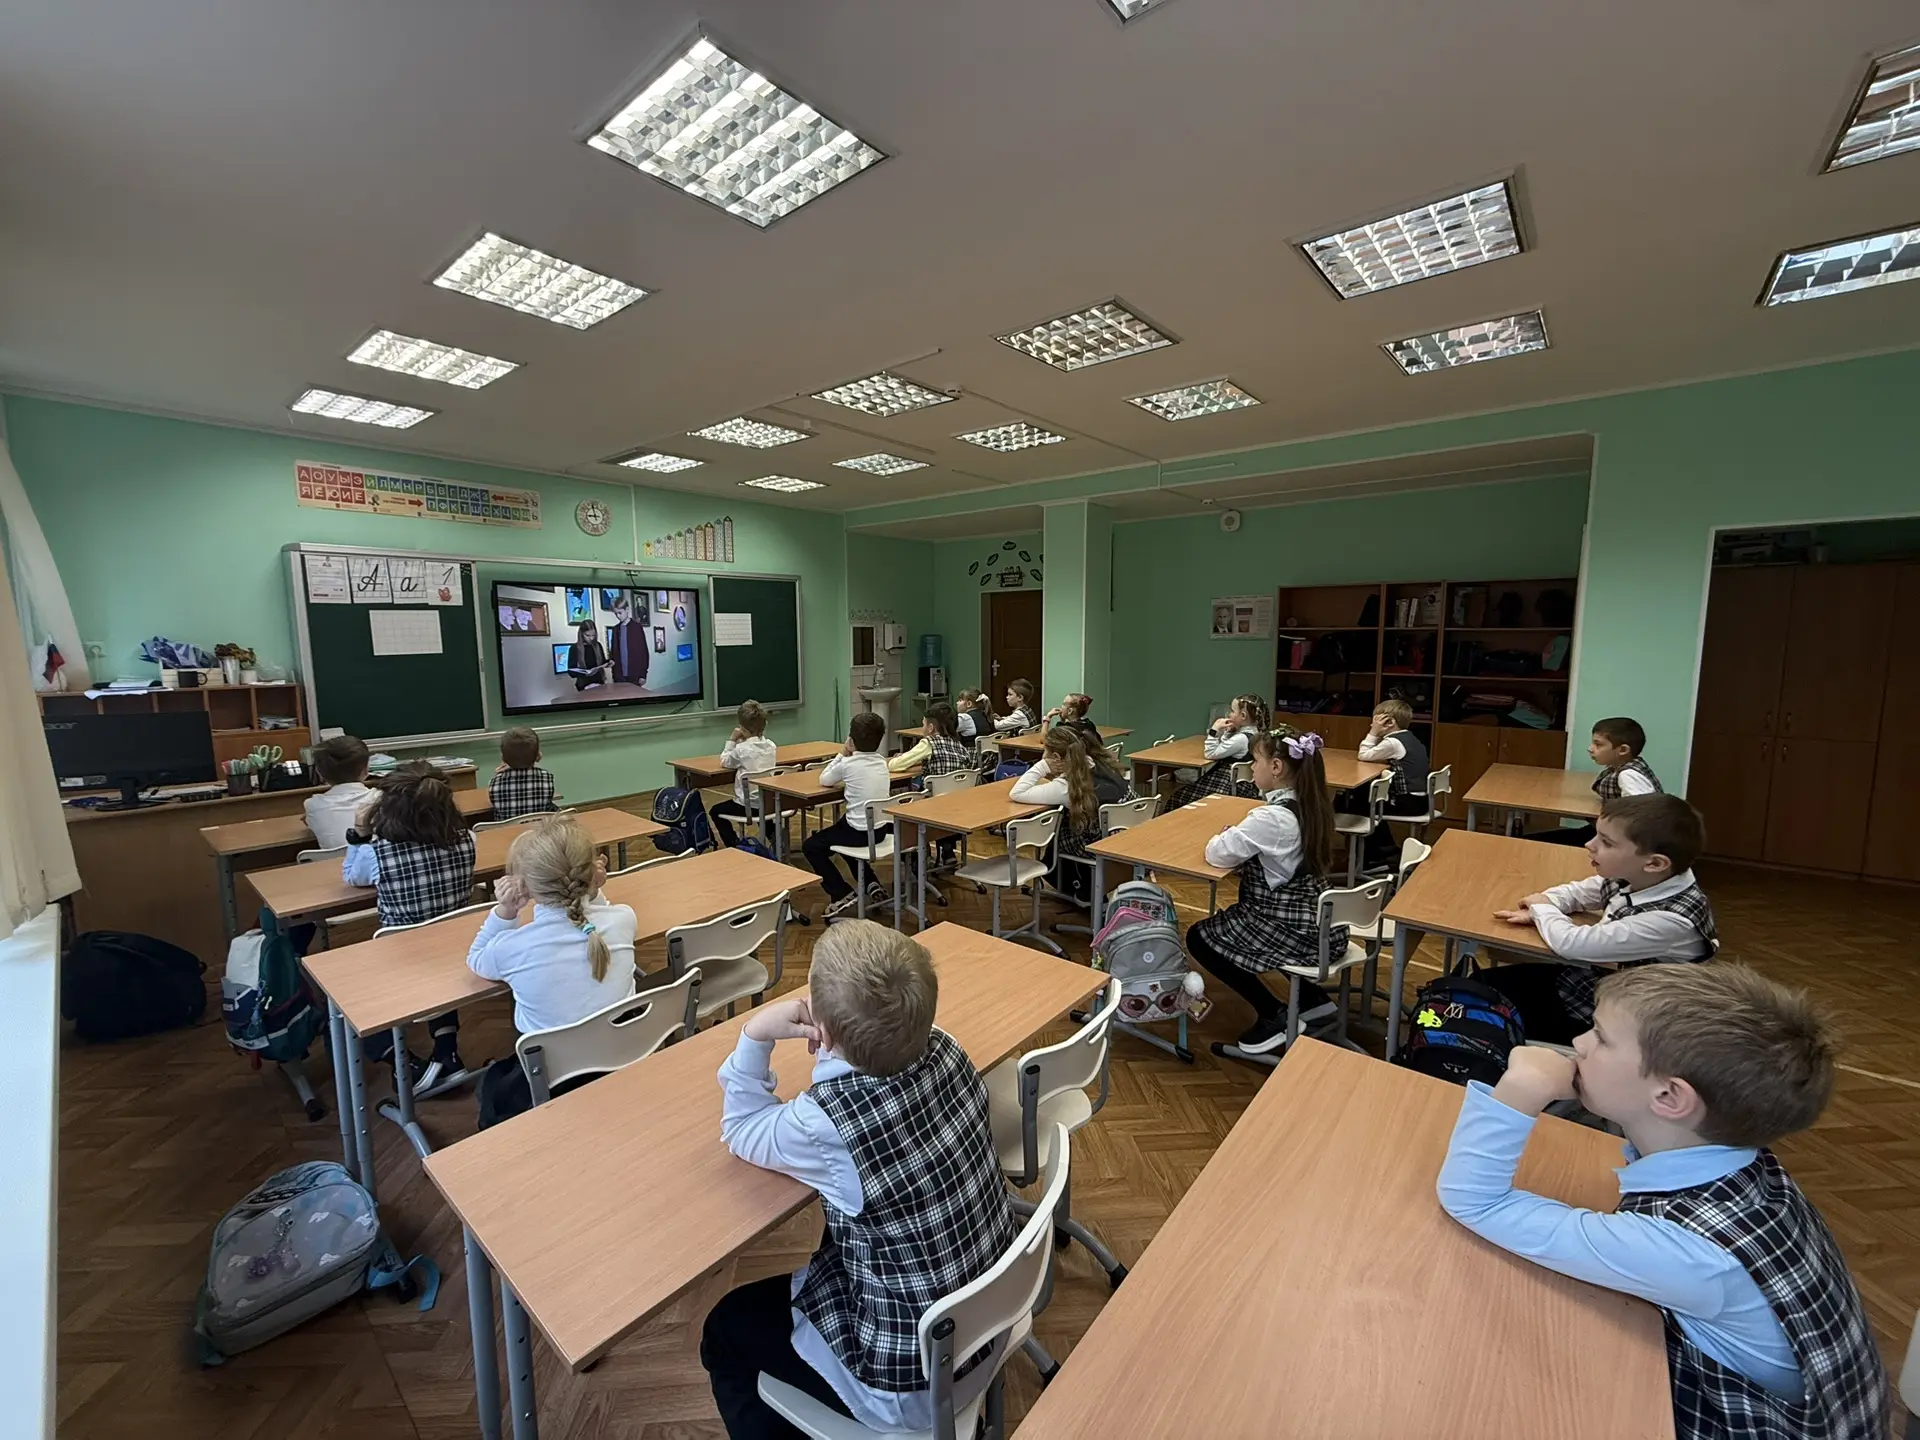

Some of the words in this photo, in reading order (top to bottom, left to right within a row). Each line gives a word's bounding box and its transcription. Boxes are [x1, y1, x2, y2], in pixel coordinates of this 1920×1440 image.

[299, 469, 309, 479] А
[313, 471, 323, 481] О
[327, 473, 336, 482] У
[339, 475, 350, 484] Ы
[353, 476, 363, 485] Э
[379, 479, 388, 488] Л
[390, 482, 400, 491] М
[403, 483, 412, 491] Н
[415, 484, 423, 492] Р
[427, 485, 435, 494] Б
[438, 486, 445, 495] В
[449, 488, 457, 496] Г
[460, 488, 469, 498] Д
[470, 491, 480, 499] Ж
[482, 492, 489, 501] З
[301, 486, 311, 496] Я
[327, 489, 340, 499] Ю
[341, 491, 351, 500] И
[355, 492, 364, 501] Е
[428, 500, 436, 509] П
[438, 502, 447, 510] Ф
[450, 503, 458, 512] К
[461, 504, 469, 512] Т
[482, 507, 490, 515] С
[493, 508, 501, 516] Х
[512, 509, 520, 517] Ч
[357, 564, 384, 592] А
[400, 576, 419, 592] а
[442, 566, 454, 586] 1
